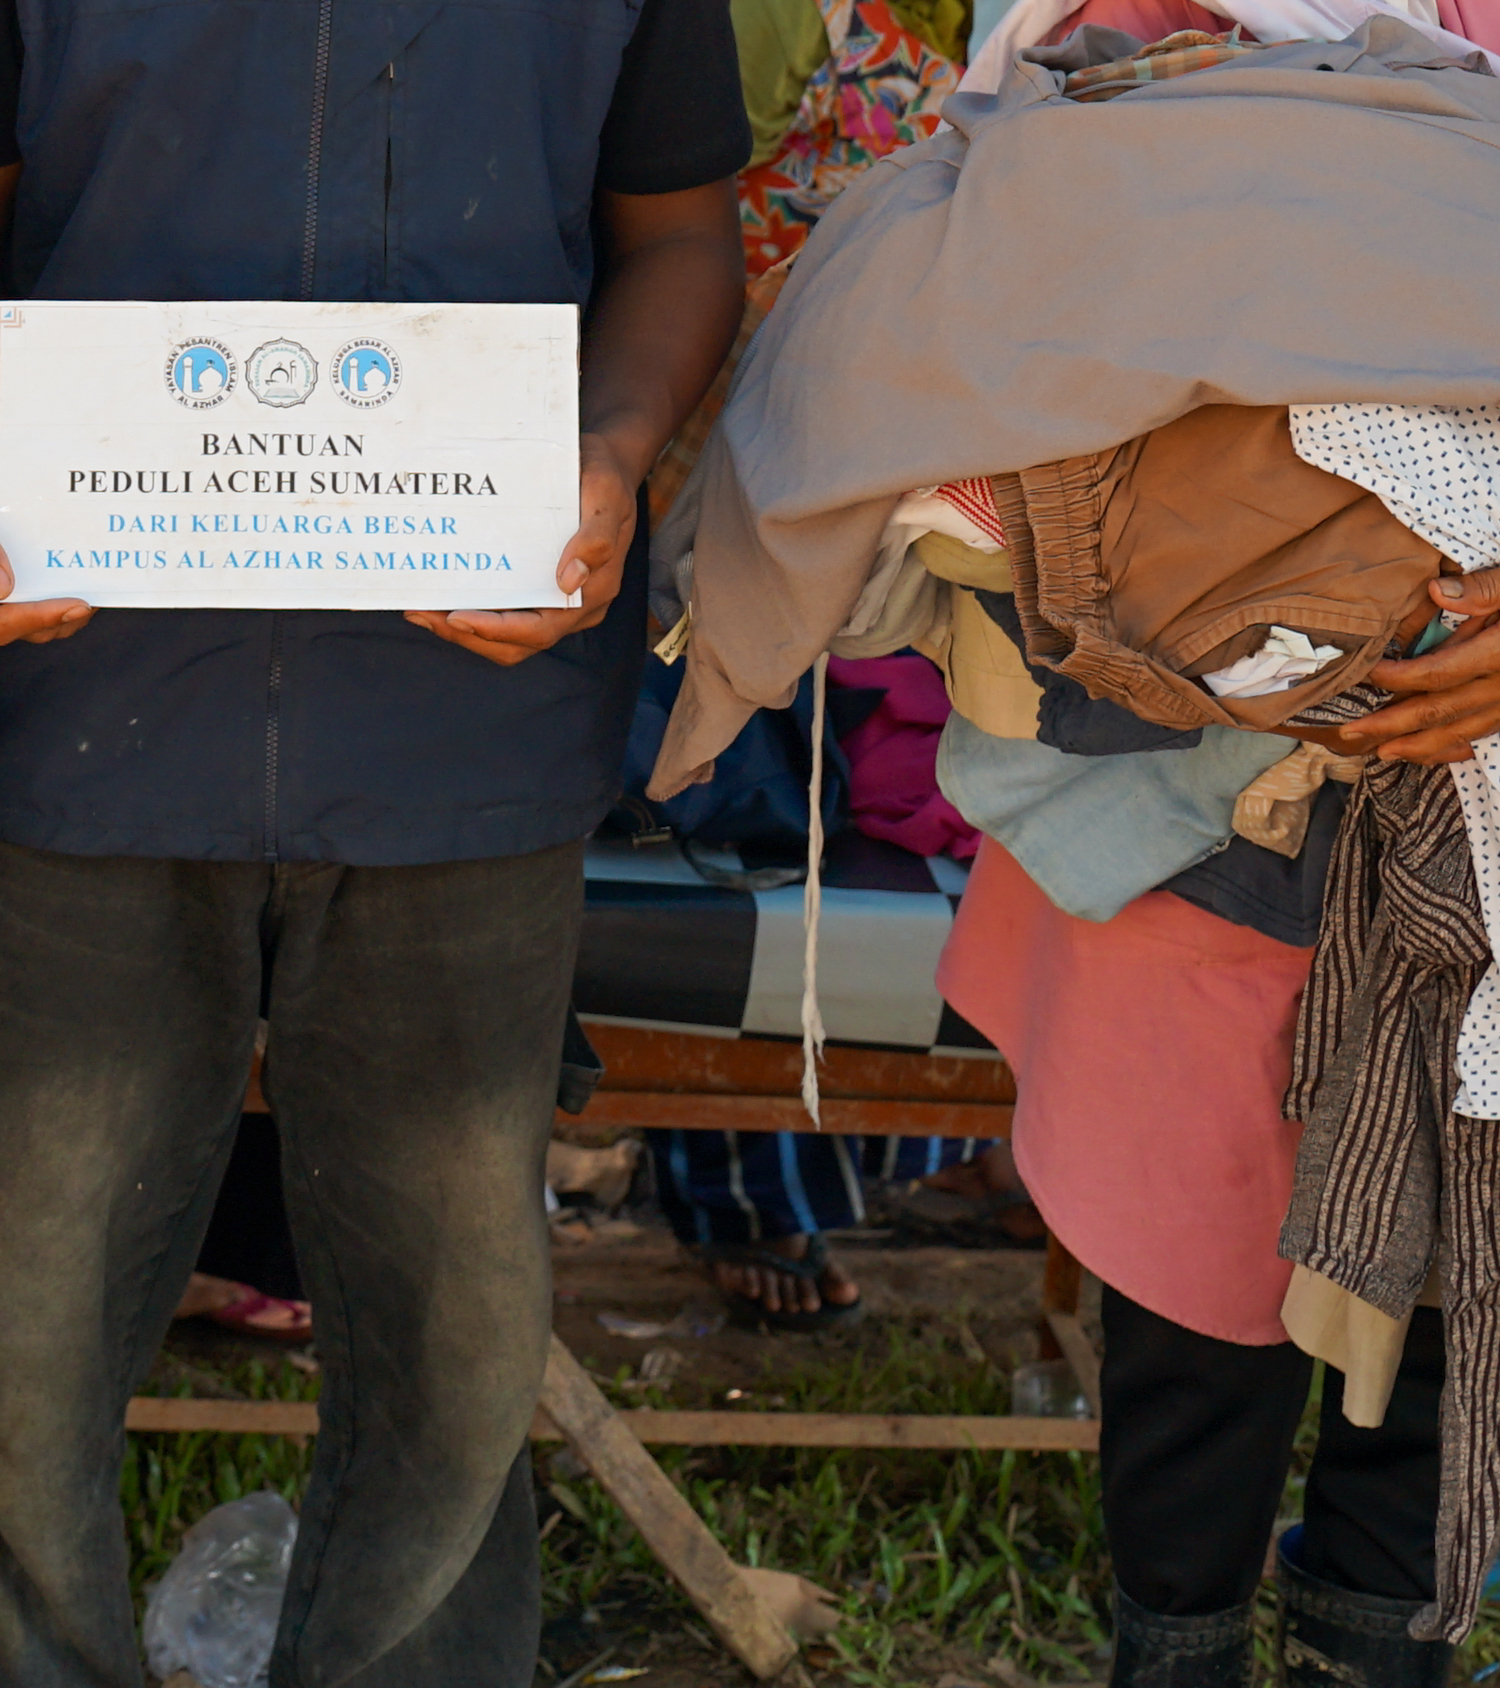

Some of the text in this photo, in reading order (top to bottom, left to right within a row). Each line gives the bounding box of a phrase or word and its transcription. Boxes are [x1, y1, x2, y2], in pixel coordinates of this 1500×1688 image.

[178, 394, 224, 409] AL AZHAR
[200, 432, 365, 457] BANTUAN
[67, 469, 499, 496] PEDULI ACEH SUMATERA
[107, 513, 458, 535] DARI KELUARGA BESAR
[45, 549, 513, 572] KAMPUS AL AZHAR SAMARINDA
